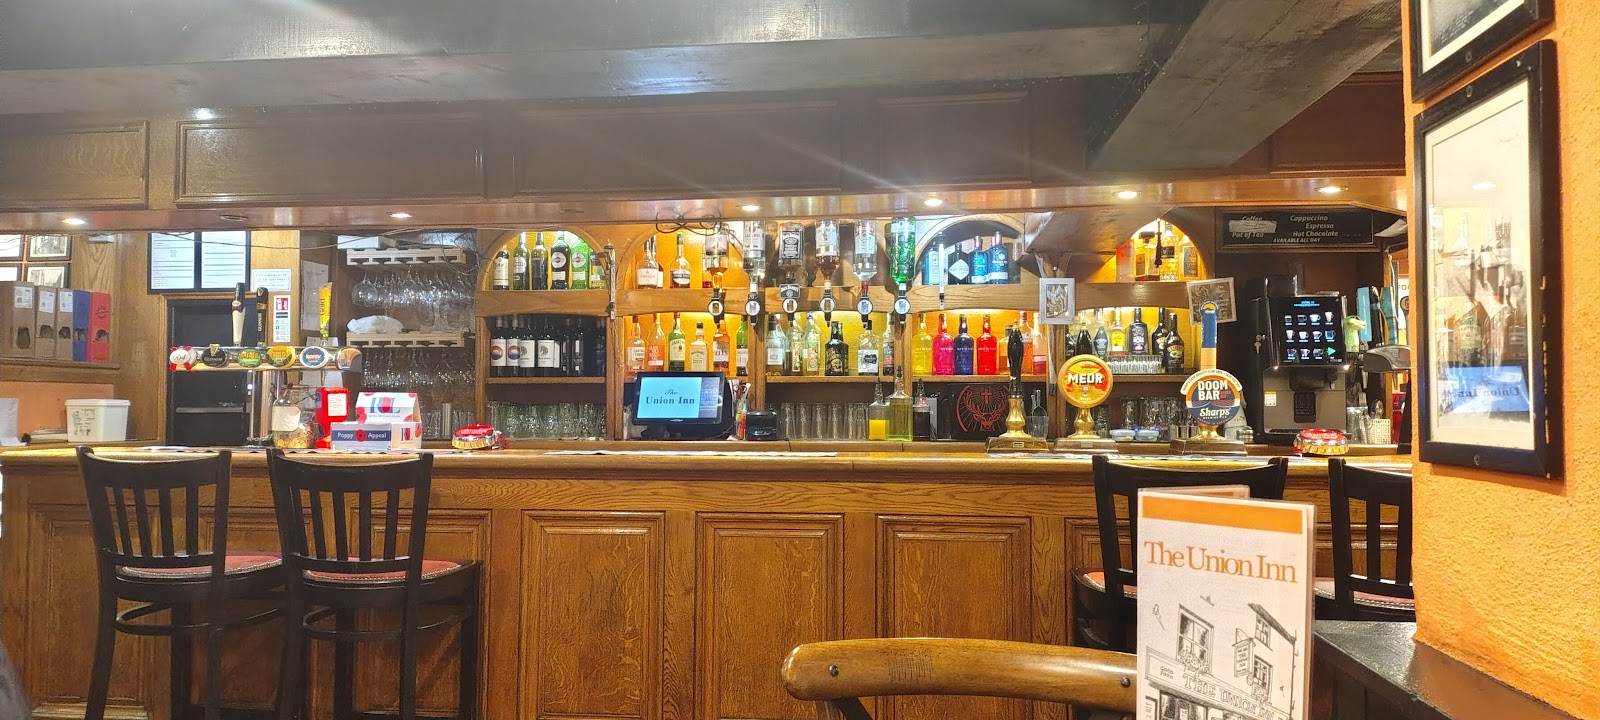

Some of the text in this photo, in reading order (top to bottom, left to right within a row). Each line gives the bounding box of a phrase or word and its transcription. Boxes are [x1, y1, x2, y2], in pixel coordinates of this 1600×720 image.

[1290, 214, 1328, 223] Cappuccino
[1197, 380, 1228, 391] DOOM
[664, 388, 679, 396] The
[1198, 390, 1220, 401] BAR
[646, 396, 695, 405] Union Inn
[367, 432, 386, 440] Appeal
[1144, 541, 1298, 584] The Union Inn
[1182, 672, 1216, 698] THE
[1220, 687, 1258, 715] UNION
